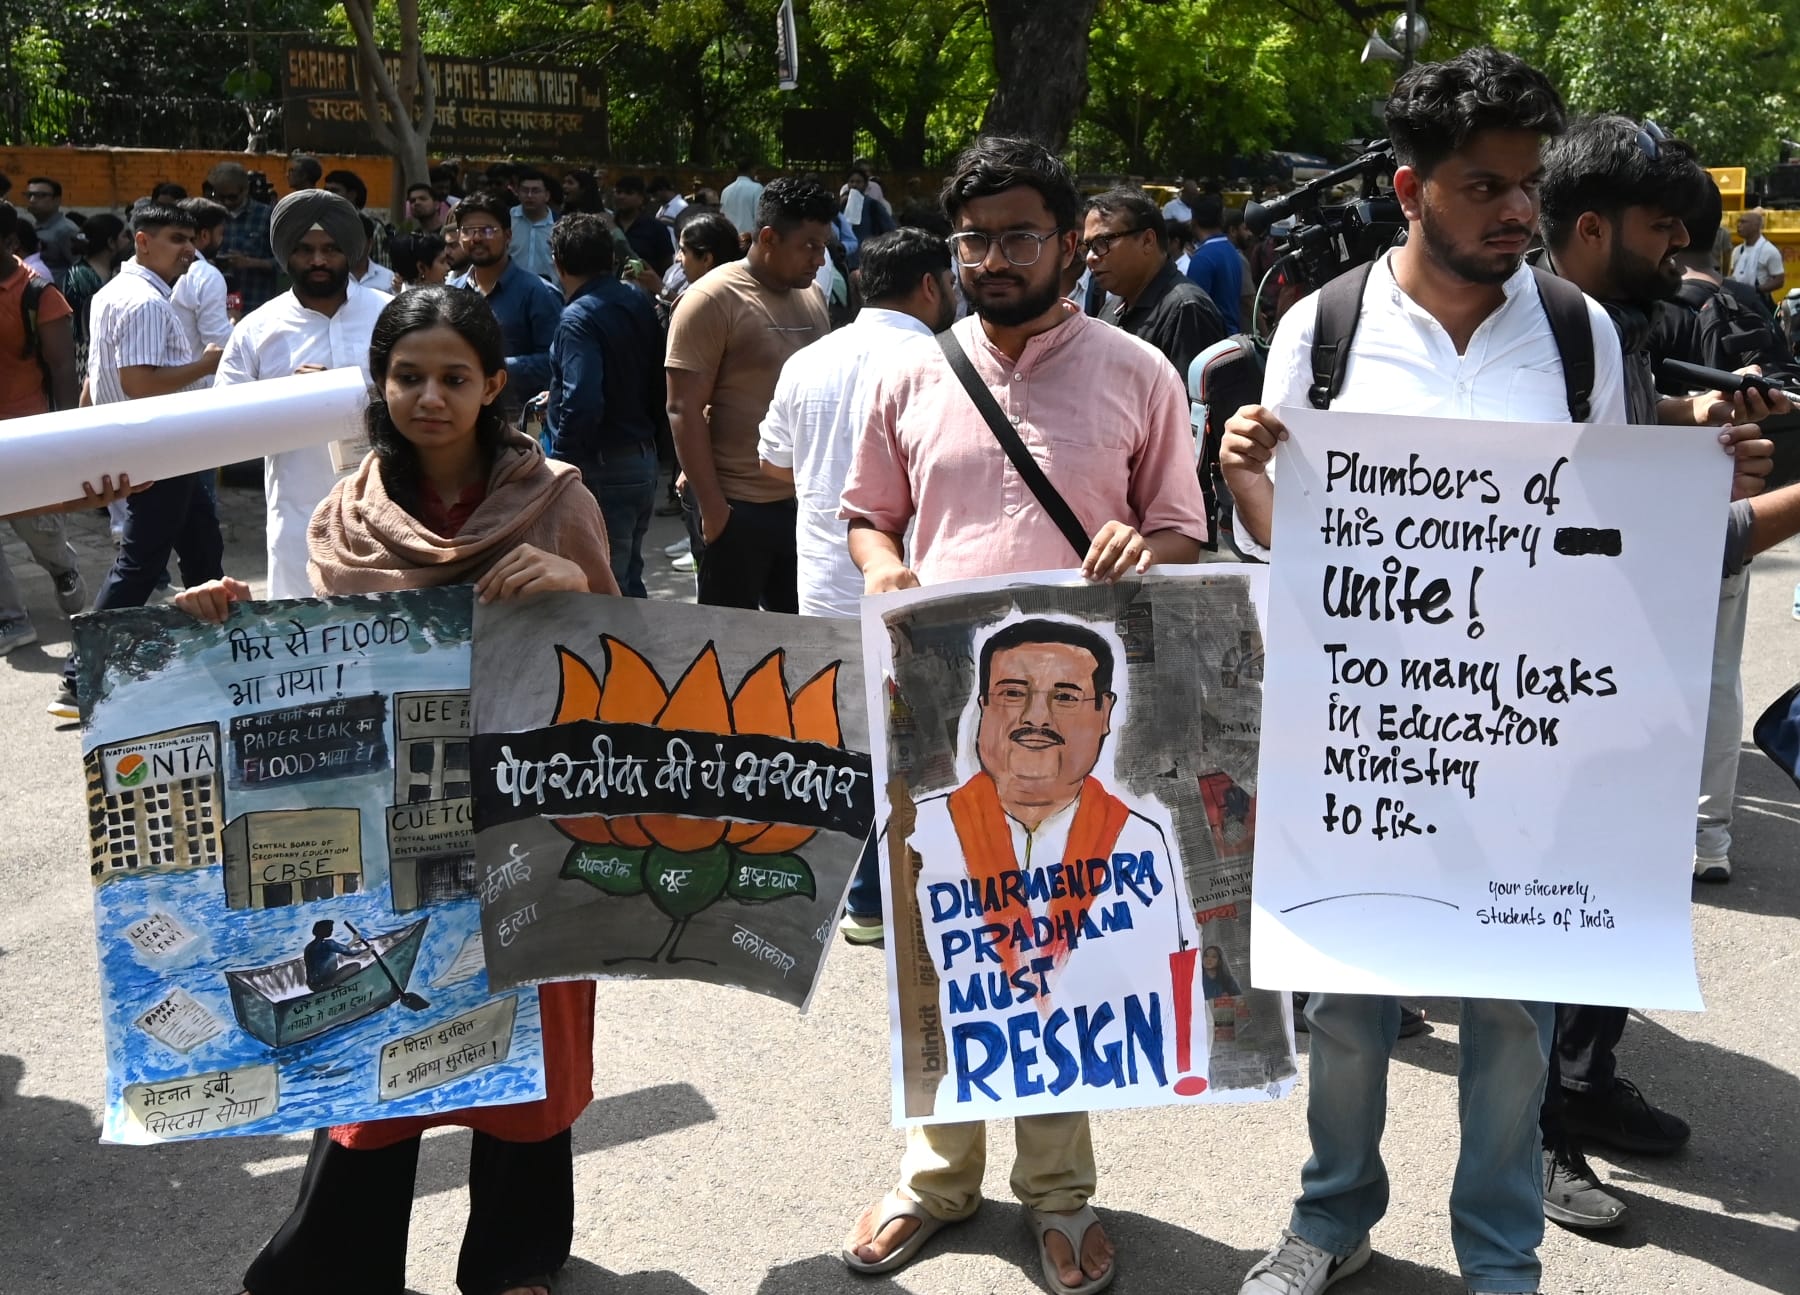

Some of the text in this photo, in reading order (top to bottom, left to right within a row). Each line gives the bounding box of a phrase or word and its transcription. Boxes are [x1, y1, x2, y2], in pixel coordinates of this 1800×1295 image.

[289, 50, 347, 89] SARDAR
[445, 63, 487, 100] PATEL
[539, 71, 578, 105] TRUST
[460, 103, 497, 128] पटेल
[500, 109, 552, 130] स्मारक
[1326, 450, 1569, 515] Plumbers of
[1321, 507, 1541, 568] this country
[229, 618, 409, 662] फिर से FLOOD
[228, 675, 265, 706] आ
[1324, 643, 1618, 711] Too many leaks
[307, 707, 324, 718] का
[356, 718, 376, 733] का
[407, 700, 454, 723] JEE
[1328, 692, 1560, 747] in Education
[105, 734, 210, 757] NATIONAL TESTING AGENCY
[153, 743, 214, 778] NTA
[244, 752, 315, 783] FLOOD
[656, 737, 696, 799] की
[1324, 745, 1480, 799] Ministry
[1322, 792, 1362, 835] to
[252, 841, 288, 850] CENTRAL
[290, 840, 317, 849] BOARD
[428, 829, 473, 841] UNIVERSIT
[447, 840, 469, 849] TEST
[302, 847, 349, 858] EDUCATION
[263, 858, 335, 882] CBSE
[659, 868, 693, 893] लूट
[927, 850, 1163, 924] DHARMENDRA
[1192, 888, 1231, 909] entered
[1476, 903, 1615, 931] Students of India
[919, 966, 935, 987] ICE
[947, 956, 1054, 1014] MUST
[144, 1000, 172, 1026] PAPER
[388, 1018, 477, 1059] न शिक्षा सुरक्षित
[918, 1003, 940, 1073] blinkit
[142, 1084, 195, 1107] मेहनत
[387, 1073, 400, 1089] न
[145, 1096, 266, 1134] सिस्टम सोया
